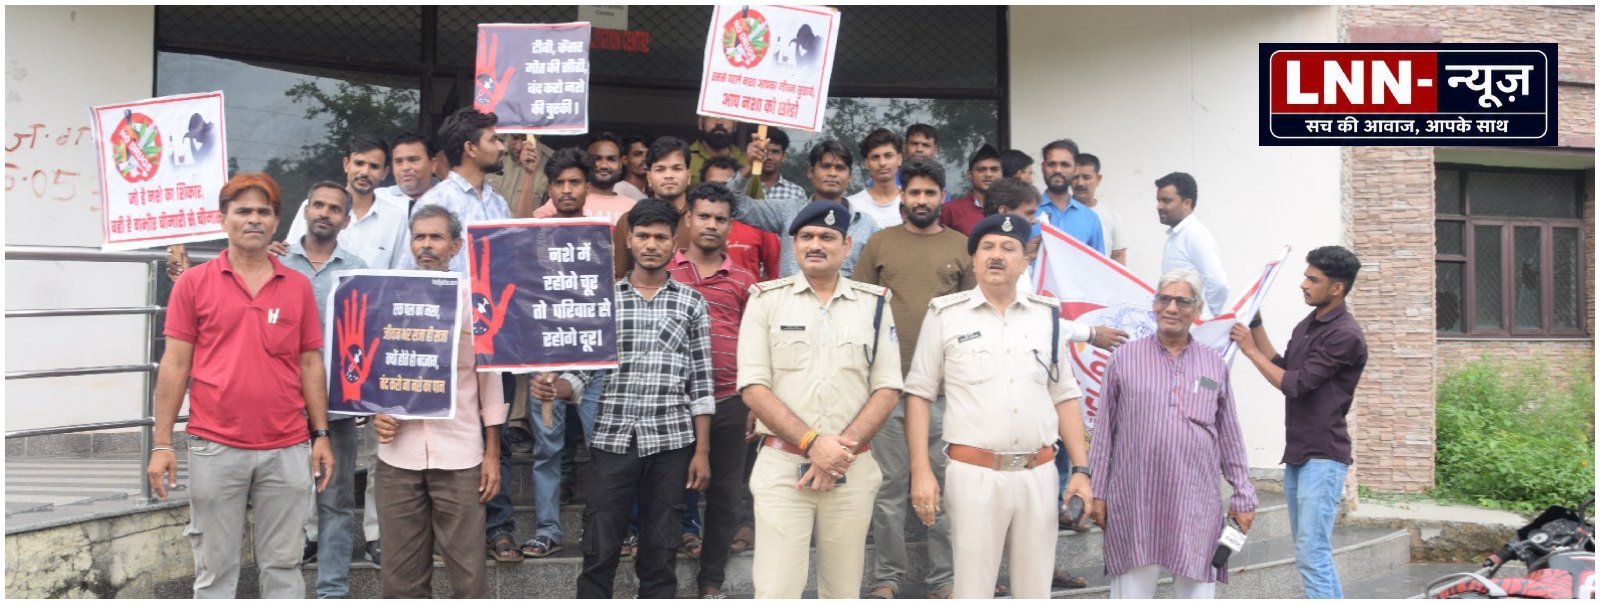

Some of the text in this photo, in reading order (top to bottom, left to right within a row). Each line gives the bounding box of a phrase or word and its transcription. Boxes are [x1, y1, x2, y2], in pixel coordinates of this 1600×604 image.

[733, 20, 756, 62] NO DRUGS
[546, 58, 560, 74] की
[527, 78, 585, 95] बंद करो नशे
[530, 99, 545, 115] की
[722, 93, 741, 108] आप
[741, 95, 763, 112] नशा
[764, 96, 777, 114] को
[129, 142, 152, 171] DRUGS
[147, 186, 162, 203] नशे
[164, 187, 174, 201] का
[159, 209, 185, 228] बीमारी
[187, 208, 196, 226] से
[548, 242, 592, 262] नशे में
[542, 271, 599, 296] रहोगे चूर
[415, 304, 424, 317] का
[532, 298, 612, 320] तो परिवार से
[383, 323, 401, 341] जीवन
[425, 325, 434, 342] ही
[542, 327, 578, 347] रहोगे
[379, 374, 389, 390] बंद
[389, 374, 402, 391] करो
[423, 379, 432, 392] का
